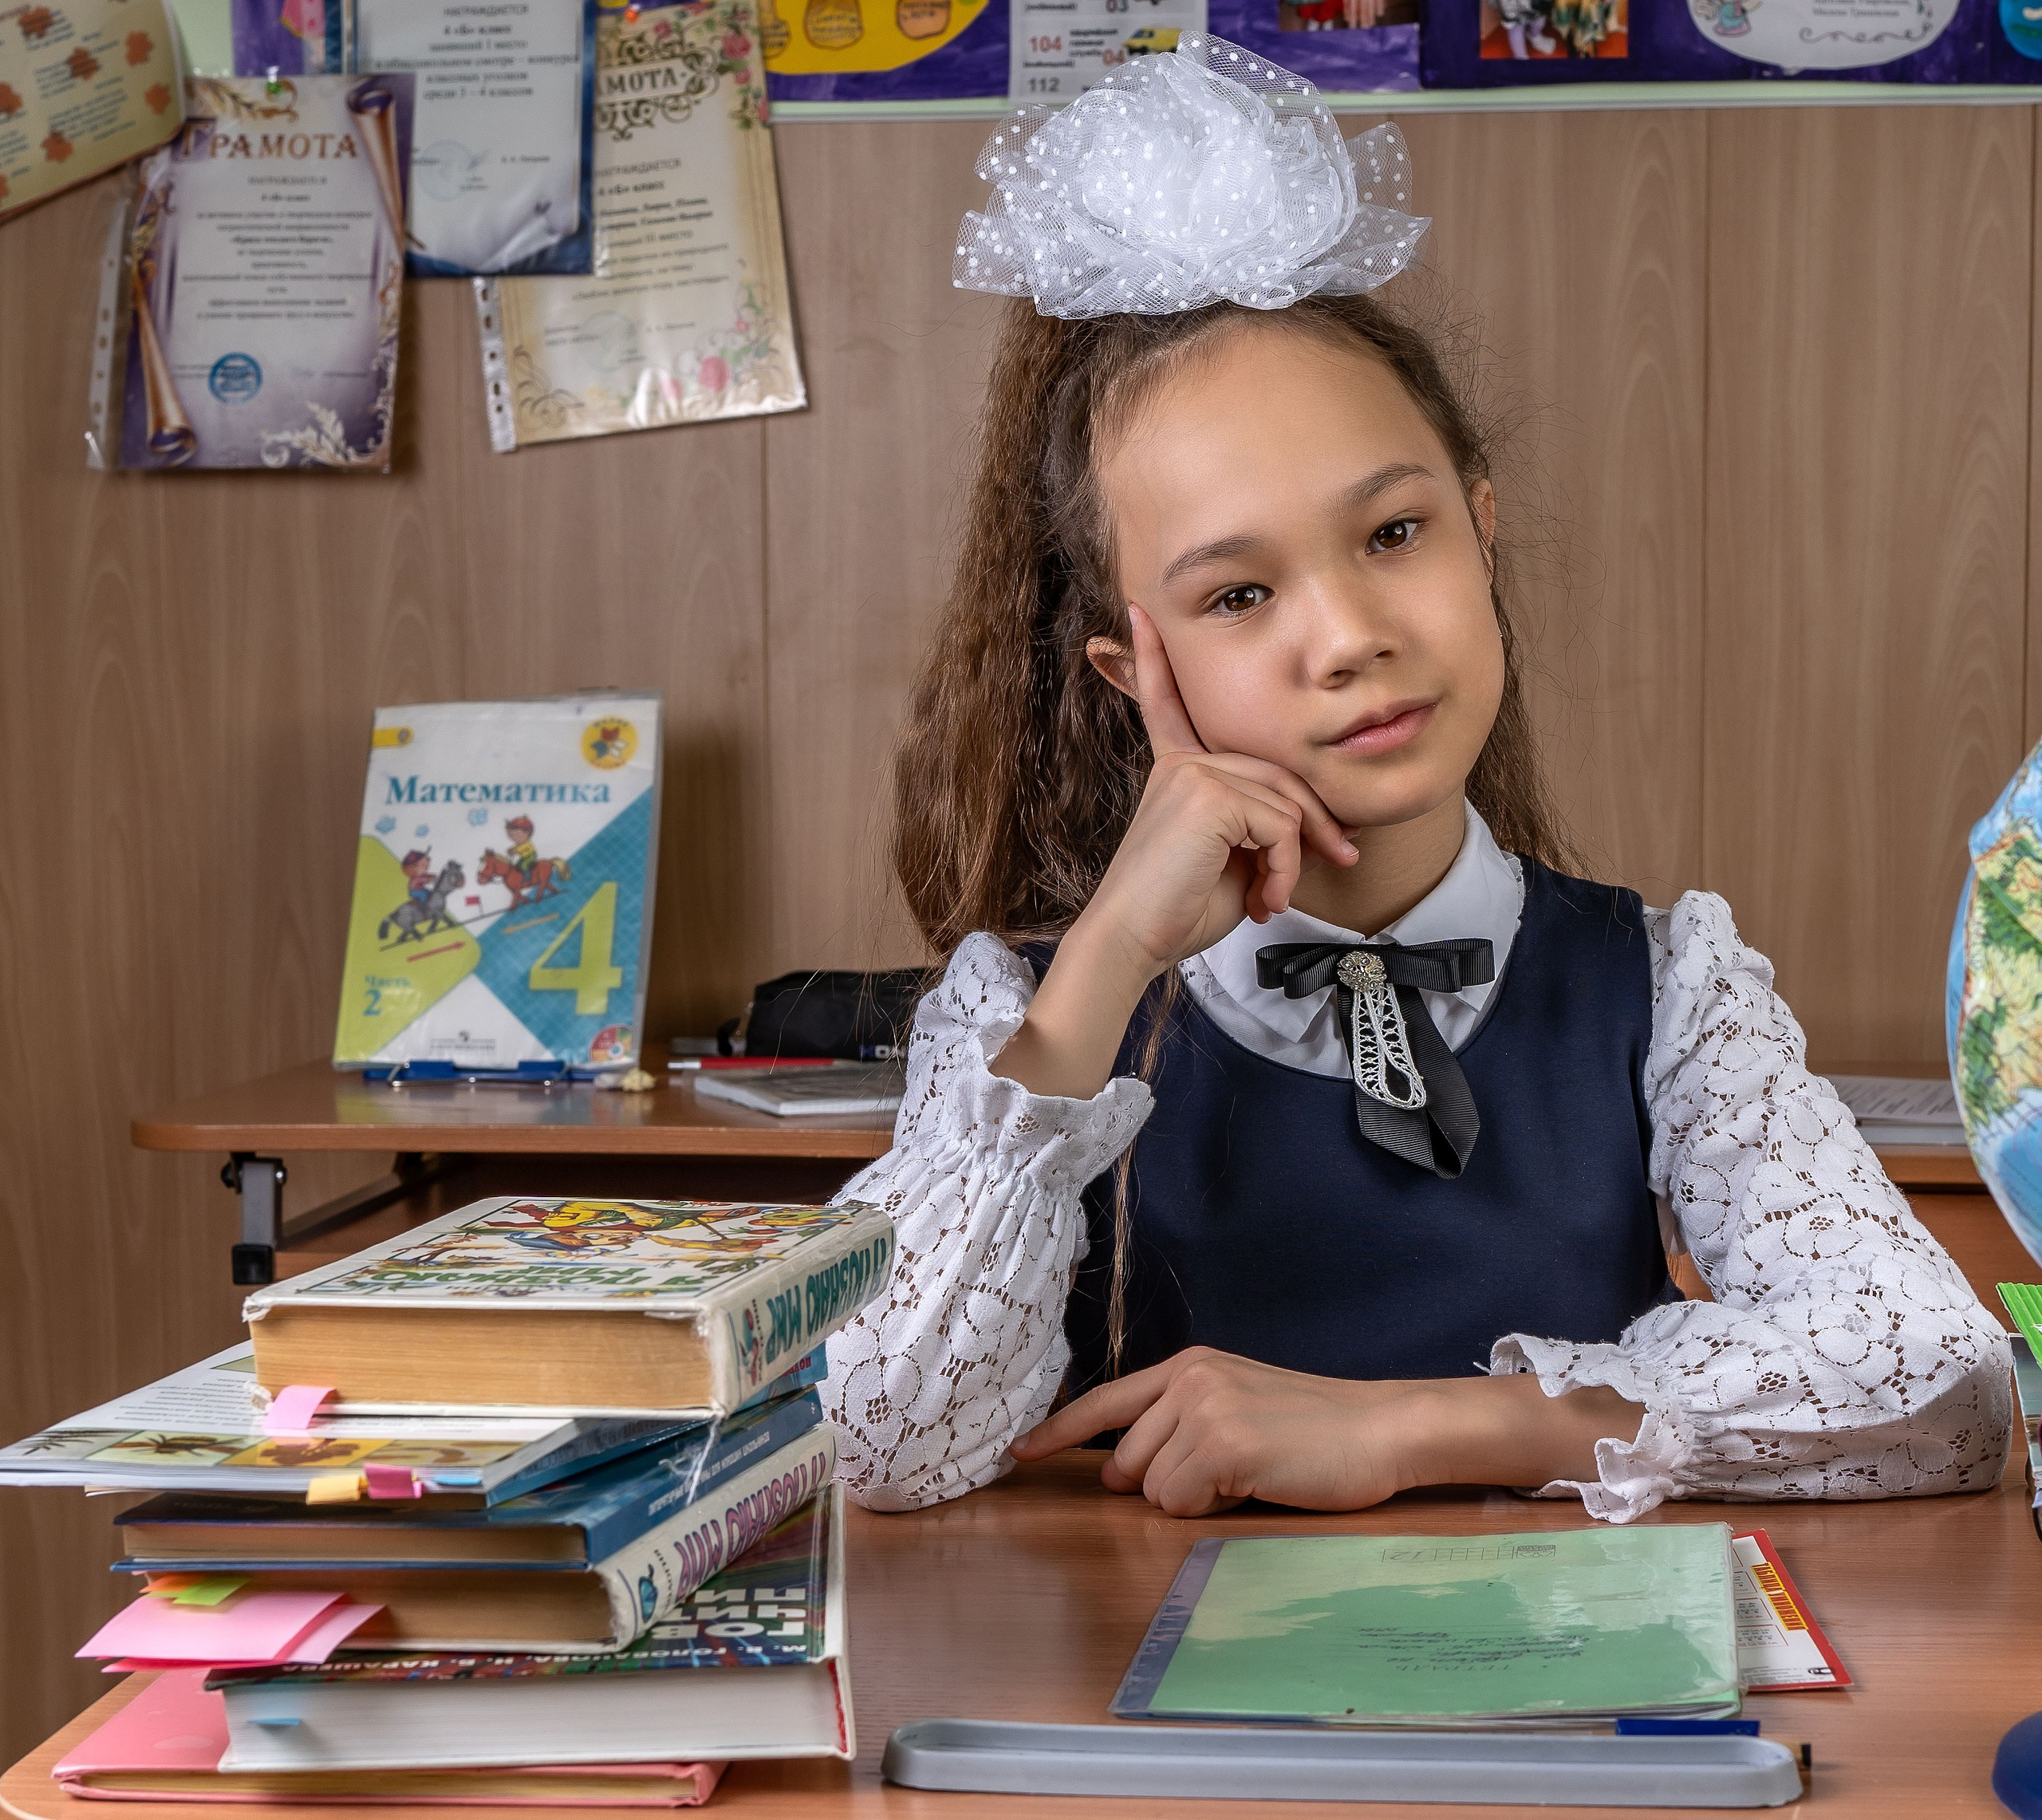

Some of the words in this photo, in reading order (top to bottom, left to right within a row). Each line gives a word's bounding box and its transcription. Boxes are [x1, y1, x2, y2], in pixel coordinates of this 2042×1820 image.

[1030, 36, 1062, 53] 104
[1102, 49, 1125, 66] 04
[599, 66, 678, 94] МОТА
[1028, 77, 1059, 93] 112
[182, 122, 357, 159] ГРАМОТА
[384, 775, 611, 804] Математика
[528, 882, 624, 1015] 4
[363, 991, 382, 1016] 2
[369, 1270, 652, 1286] ПОЗНАЮ
[493, 1266, 646, 1276] МИР
[806, 1247, 871, 1337] ПОЗНАЮ
[765, 1285, 802, 1365] МИР
[725, 1463, 807, 1564] ПОЗНАЮ
[673, 1519, 723, 1603] МИР
[678, 1588, 806, 1603] ПИ
[656, 1604, 806, 1621] ЧИТ
[652, 1621, 804, 1640] ГОВ
